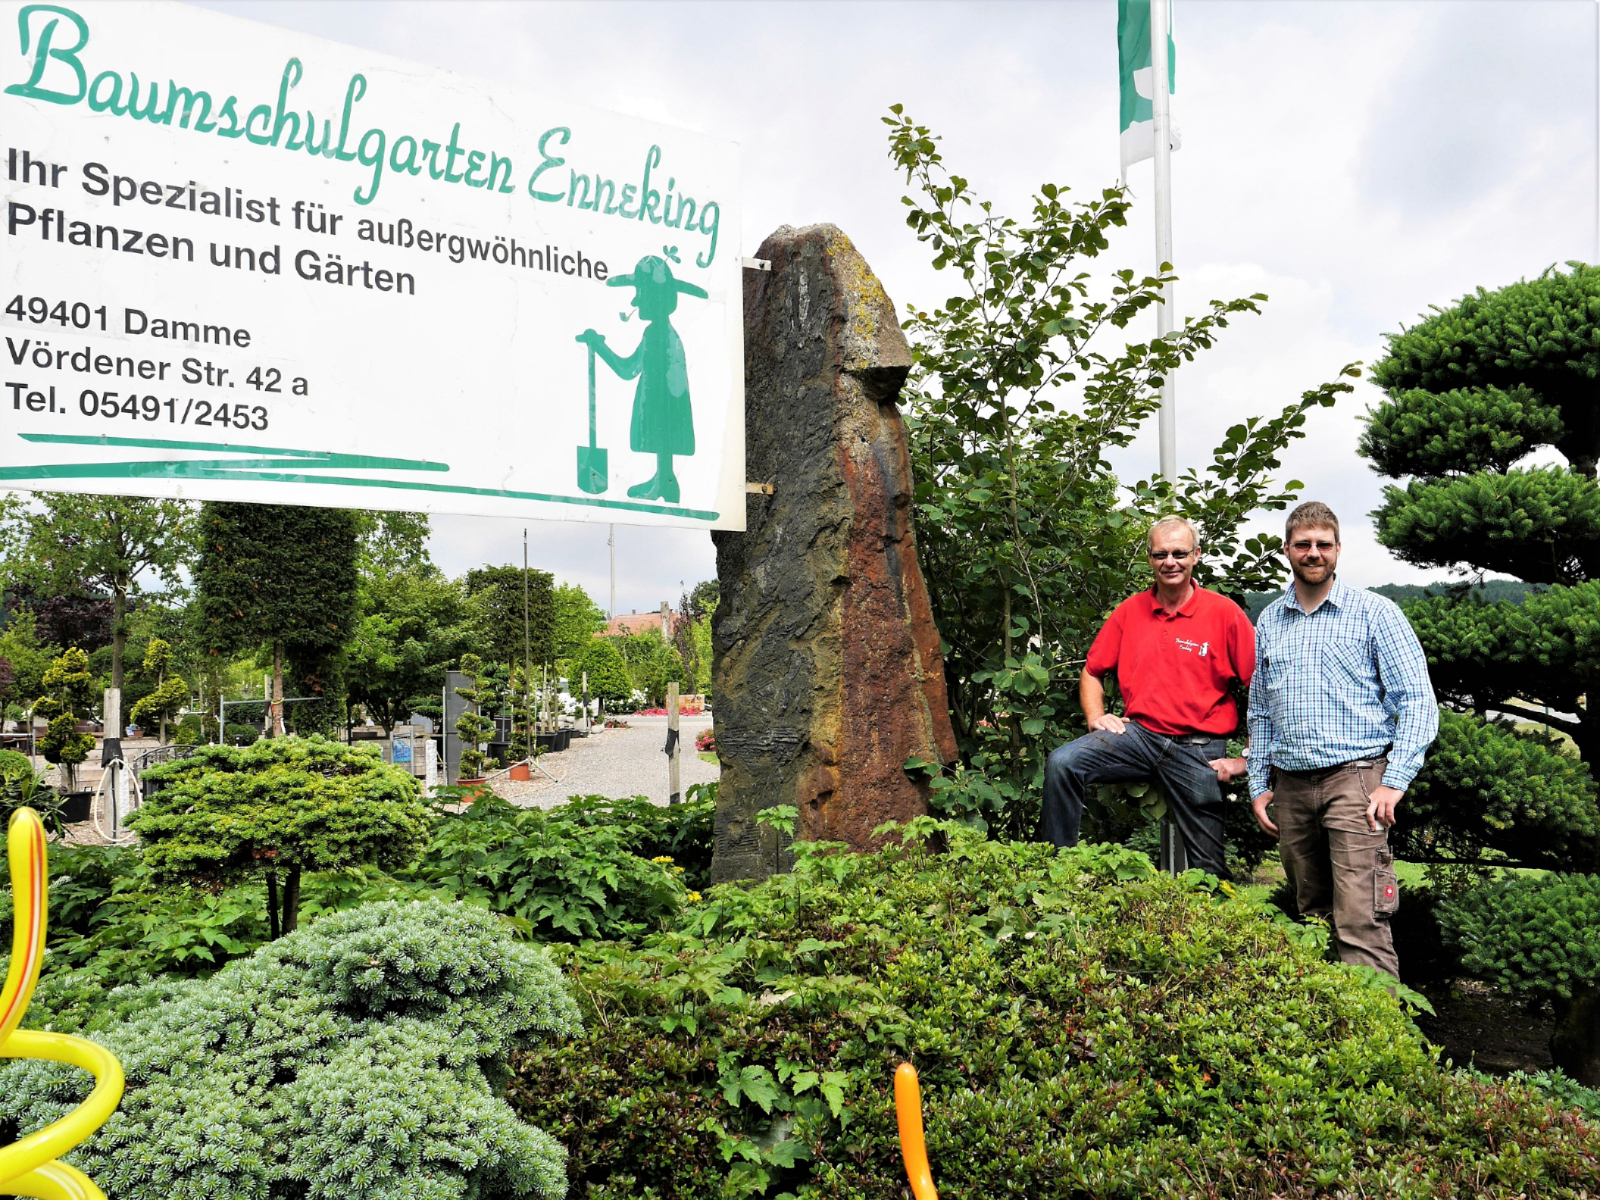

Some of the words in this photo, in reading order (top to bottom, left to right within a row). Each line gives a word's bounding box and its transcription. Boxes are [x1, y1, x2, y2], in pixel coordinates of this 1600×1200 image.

[5, 5, 515, 205] Baumschulgarten
[528, 126, 720, 269] Enneking
[8, 147, 67, 188] Ihr
[82, 162, 280, 226] Spezialist
[291, 201, 343, 236] für
[357, 218, 609, 281] außergwöhnliche
[8, 201, 194, 262] Pflanzen
[210, 243, 280, 275] und
[295, 250, 415, 295] Gärten
[5, 295, 107, 331] 49401
[124, 308, 251, 348] Damme
[5, 336, 171, 381] Vördener
[181, 357, 235, 388] Str.
[246, 366, 282, 393] 42
[292, 377, 309, 396] a
[5, 382, 66, 414] Tel.
[79, 390, 268, 431] 05491/2453
